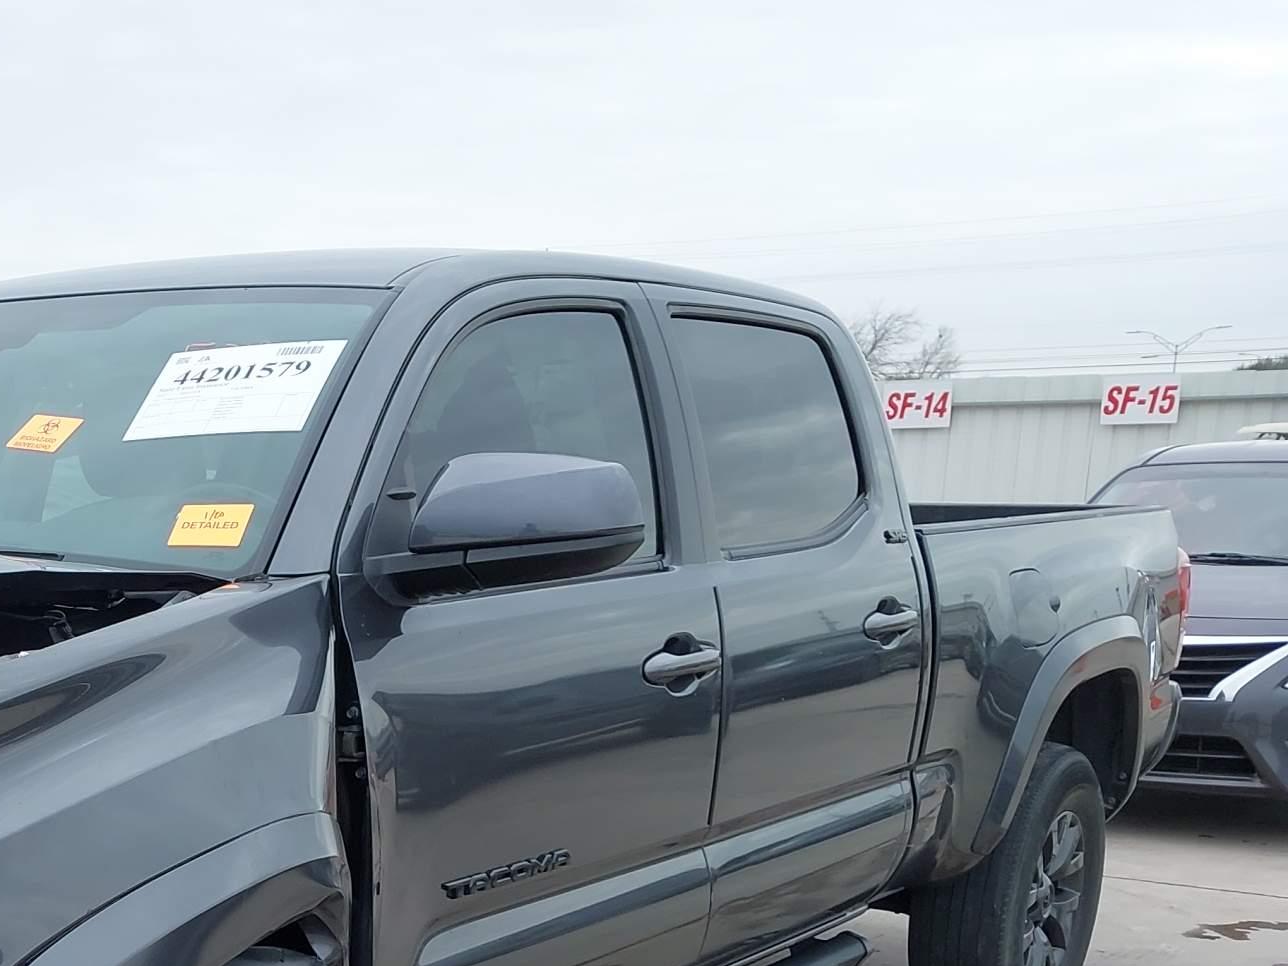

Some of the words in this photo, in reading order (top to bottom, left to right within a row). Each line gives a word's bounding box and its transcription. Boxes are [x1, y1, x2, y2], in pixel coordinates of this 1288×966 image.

[173, 359, 312, 385] 44201579
[885, 390, 949, 420] SF-14
[1103, 385, 1179, 416] SF-15
[181, 521, 239, 530] DETAILED
[441, 848, 570, 899] TACOMA
